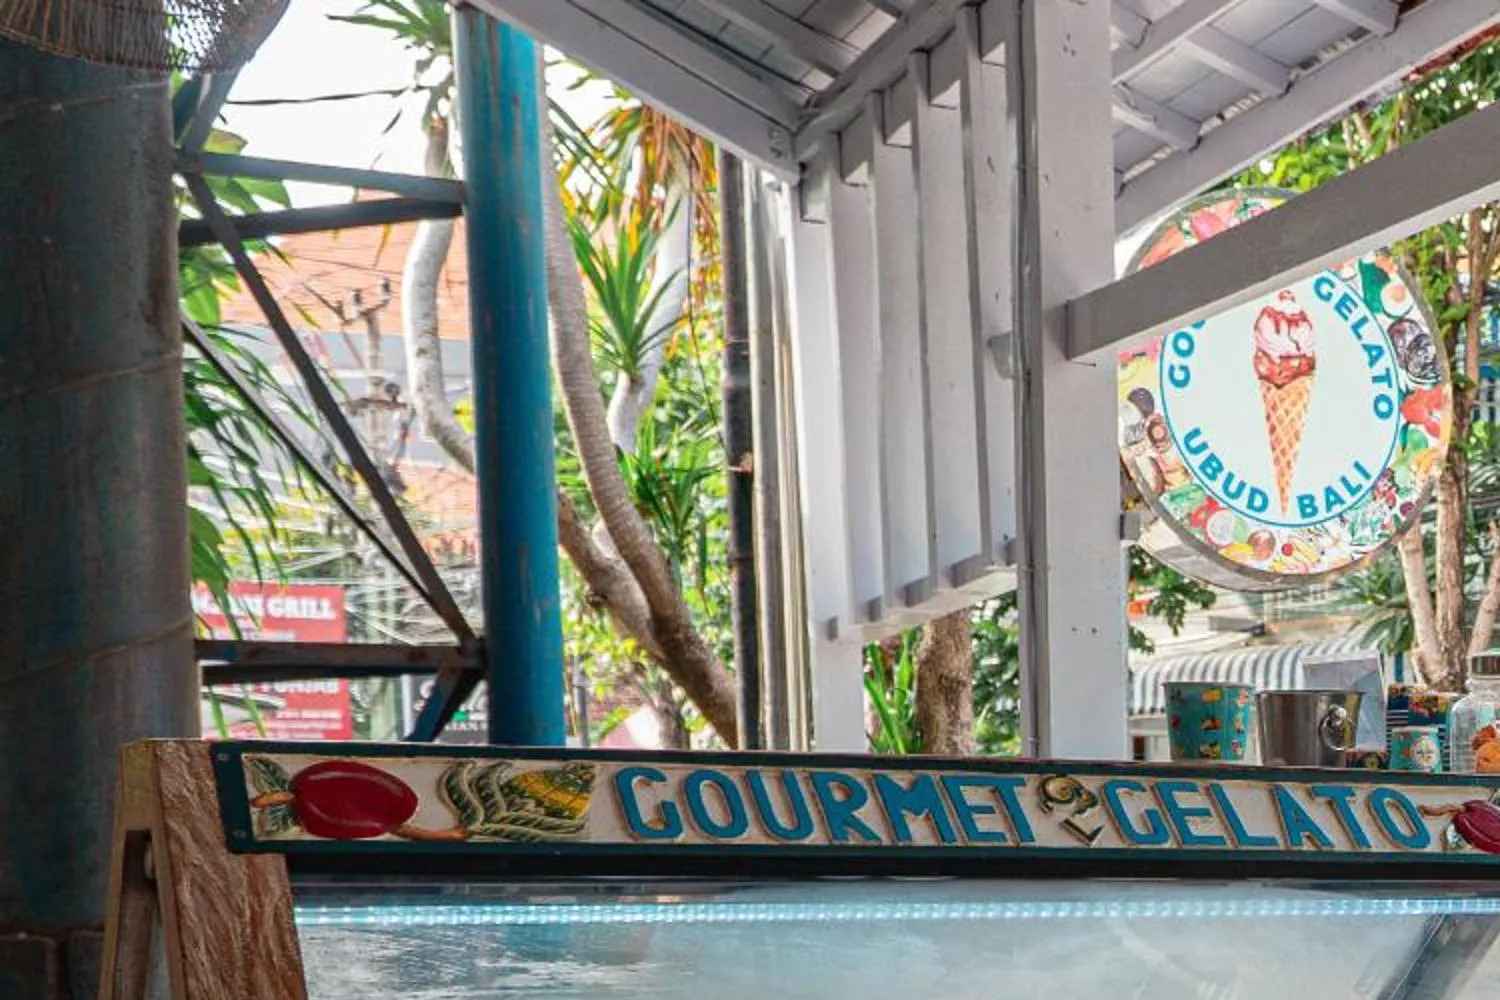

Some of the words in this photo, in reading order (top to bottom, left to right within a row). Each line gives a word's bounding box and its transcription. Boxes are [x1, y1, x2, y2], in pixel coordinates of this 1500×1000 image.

[1313, 276, 1394, 420] GELATO
[1183, 428, 1270, 513] UBUD
[1296, 460, 1372, 519] BALI
[615, 766, 1034, 846] GOURMET
[1099, 778, 1432, 851] GELATO
